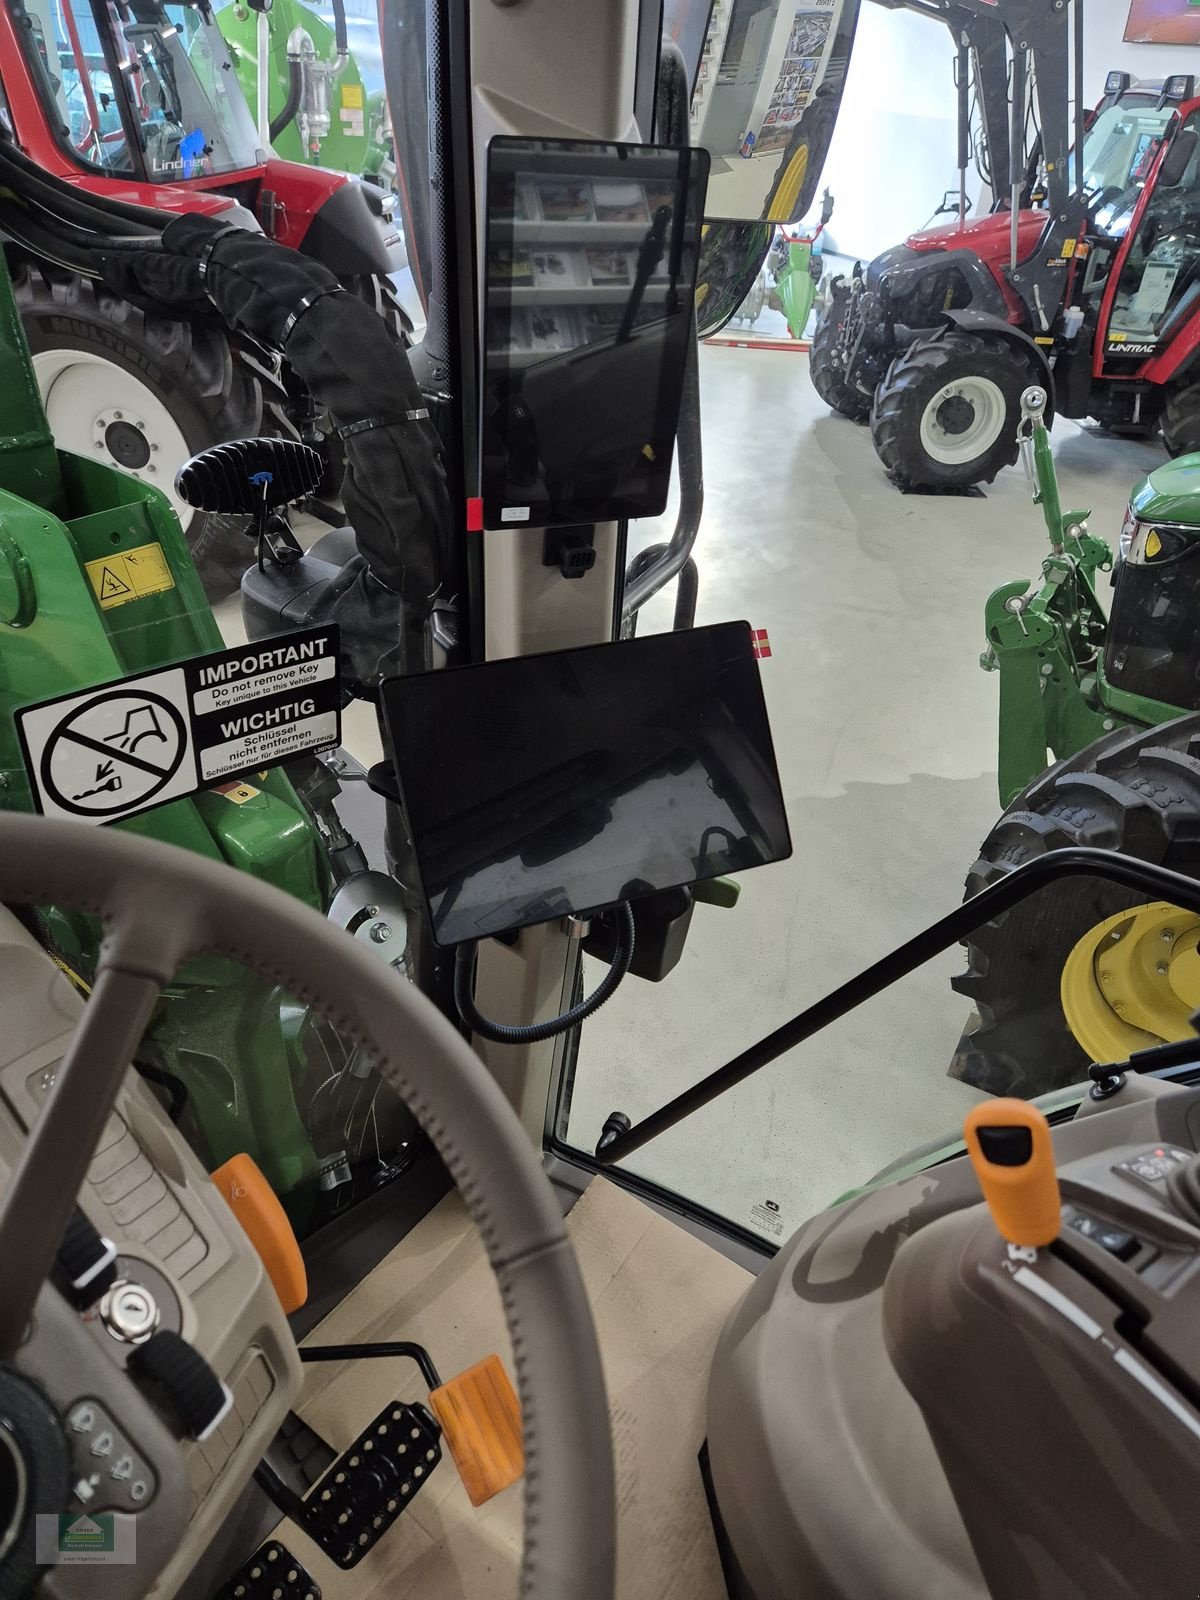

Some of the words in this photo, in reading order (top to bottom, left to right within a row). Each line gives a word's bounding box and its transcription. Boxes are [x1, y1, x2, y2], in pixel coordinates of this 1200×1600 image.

[152, 156, 208, 172] Lindner
[1108, 343, 1156, 353] LINTRAC
[199, 638, 328, 686] IMPORTANT
[212, 688, 229, 699] Do
[232, 680, 251, 693] not
[254, 670, 296, 687] remove
[299, 663, 319, 675] Key
[215, 698, 232, 708] Key
[233, 690, 261, 703] unique
[273, 681, 288, 691] this
[289, 675, 317, 687] Vehicle
[220, 698, 315, 738] WICHTIG
[229, 746, 258, 761] nicht
[260, 730, 312, 751] entfernen
[243, 723, 297, 747] Schlüssel
[205, 760, 245, 778] Schlüssel
[246, 756, 259, 765] nur
[261, 752, 272, 762] für
[274, 743, 298, 756] dieses
[299, 733, 334, 748] Fahrzeug
